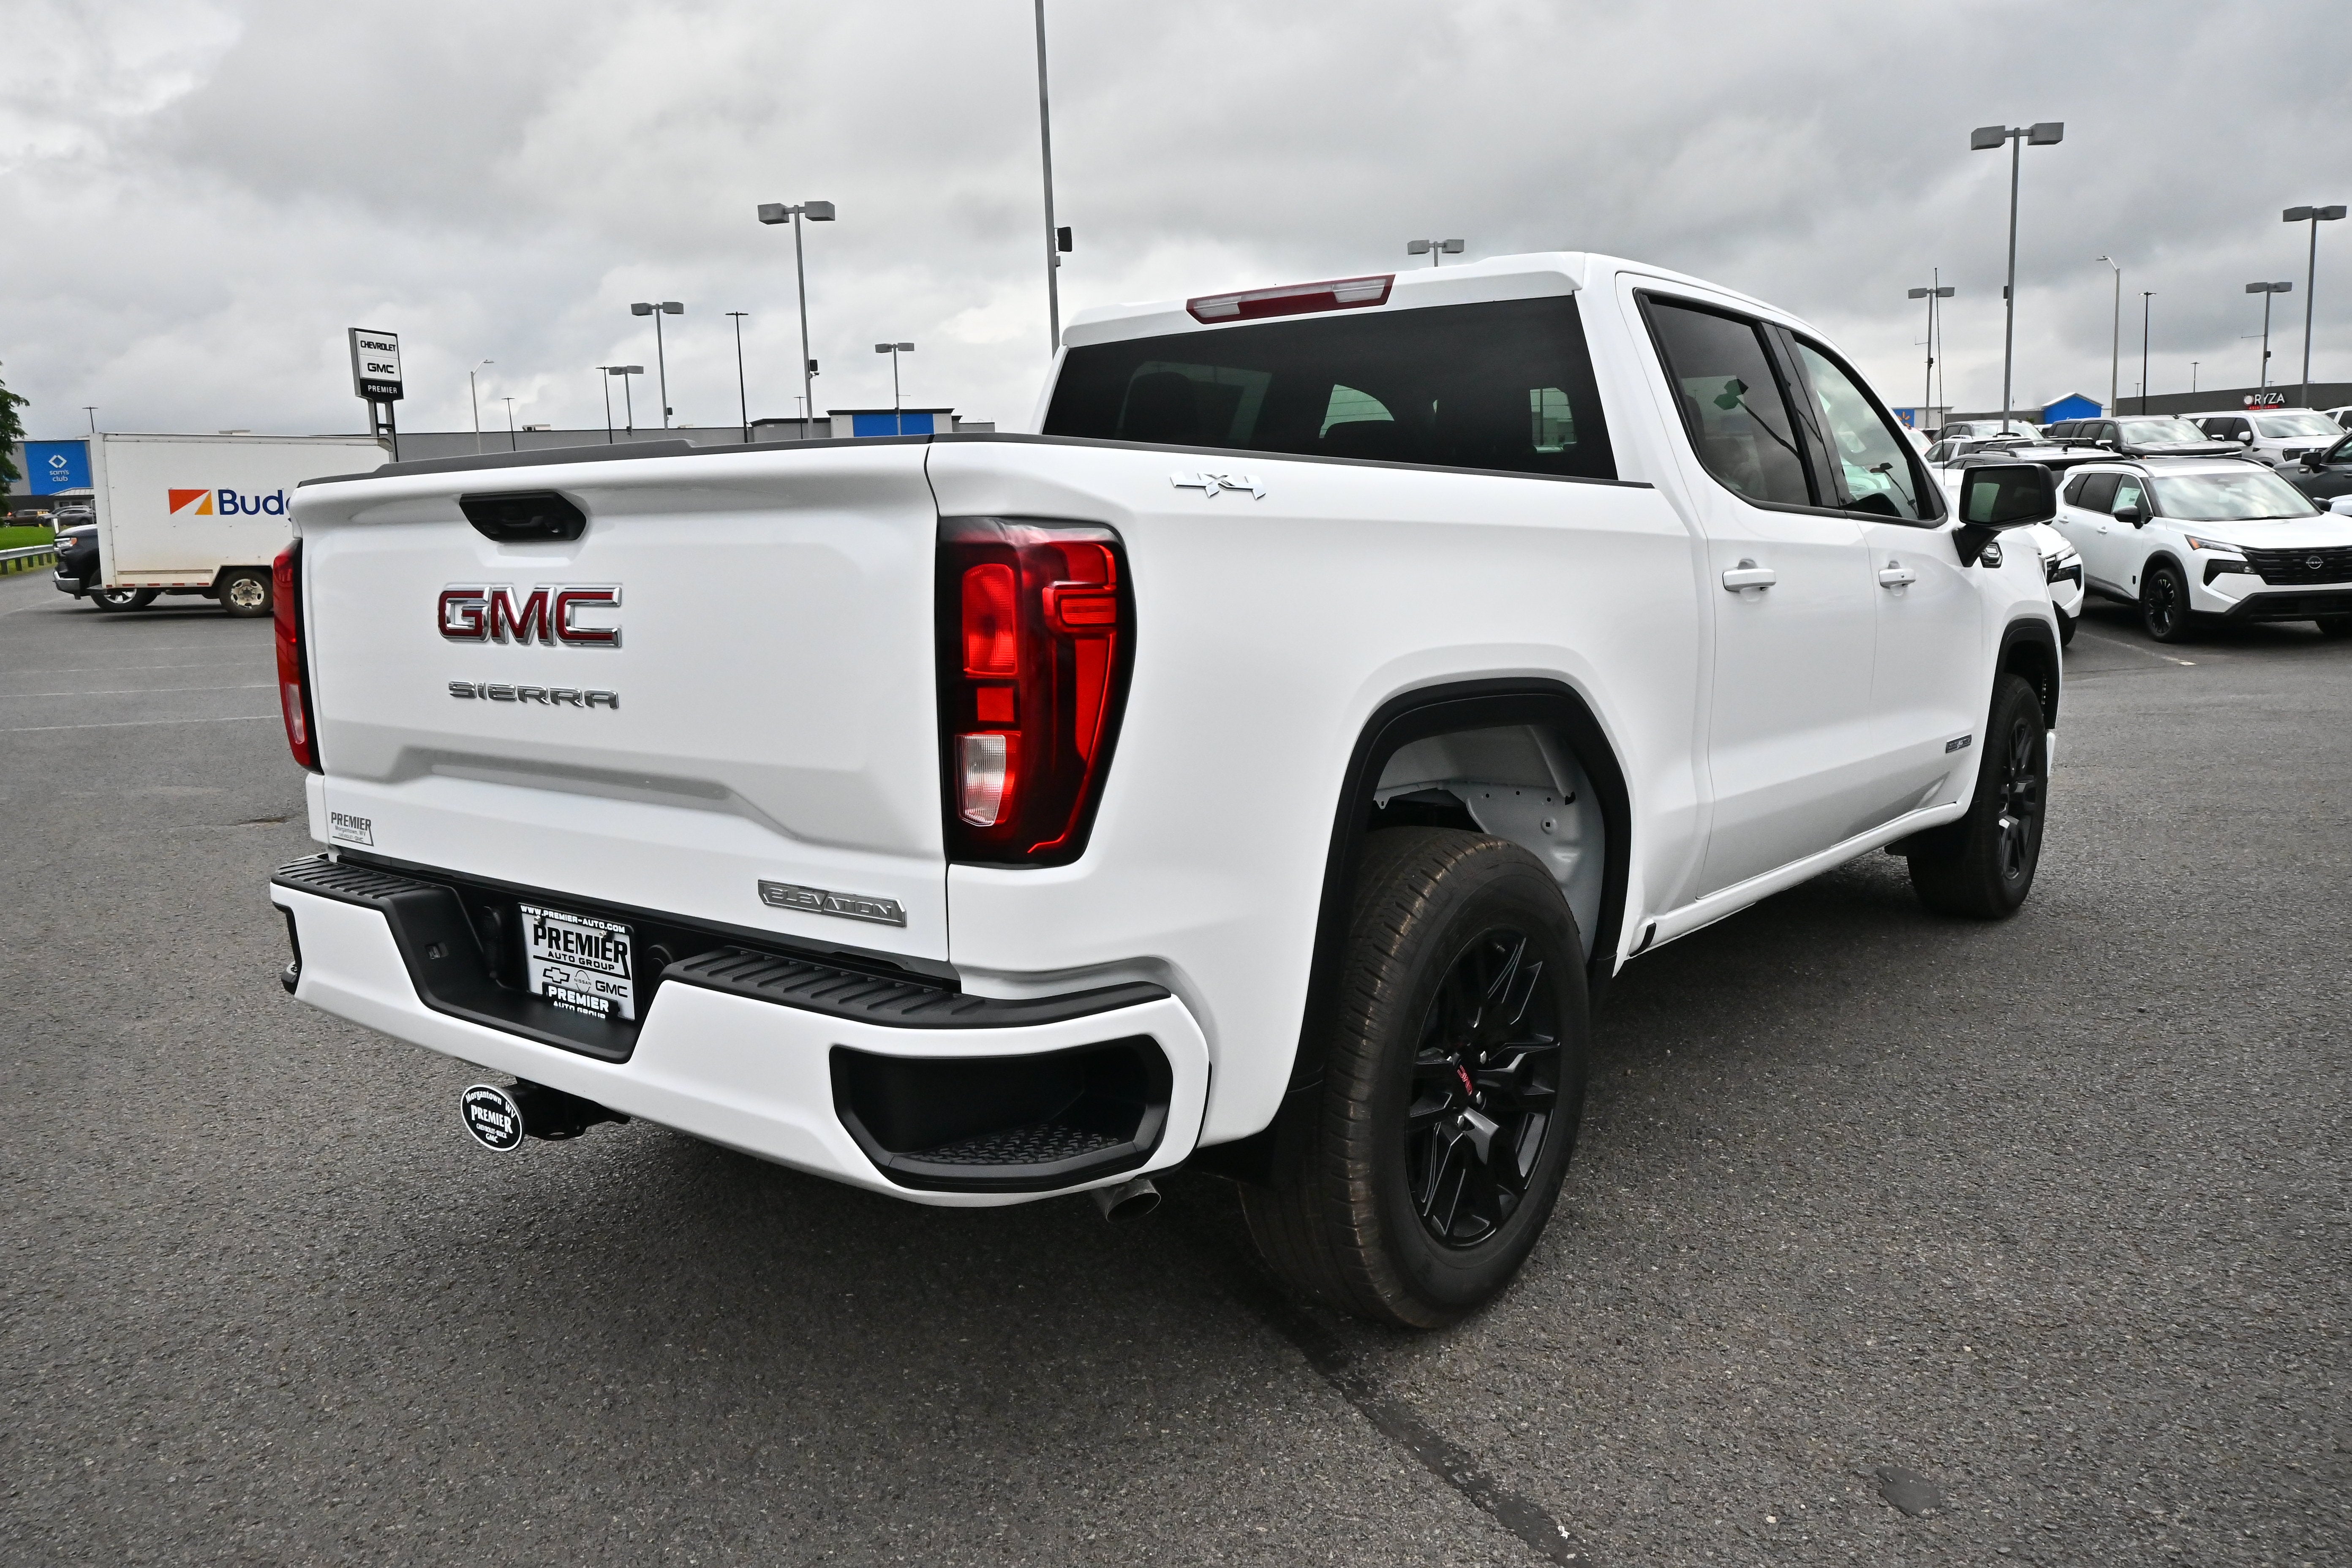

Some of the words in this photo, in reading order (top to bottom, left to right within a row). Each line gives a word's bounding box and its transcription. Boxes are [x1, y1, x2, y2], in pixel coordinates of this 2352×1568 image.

[360, 340, 396, 351] CHEVROLET
[367, 362, 395, 374] GMC
[368, 384, 397, 394] PREMIER
[218, 490, 291, 522] Bud
[437, 586, 623, 648] GMC
[448, 680, 619, 710] SIERRA
[331, 811, 371, 831] PREMIER
[768, 887, 892, 917] ELEVATION
[520, 905, 625, 934] WWW.PREMIER-AUTO.COM
[533, 924, 628, 964] PREMIER
[548, 951, 575, 963] AUTO
[578, 957, 615, 971] GROUP
[548, 985, 609, 1013] PREMIER
[595, 980, 628, 998] GMC
[465, 1091, 502, 1105] Morgantown
[505, 1101, 516, 1119] WV
[471, 1104, 513, 1134] PREMIER
[485, 1133, 498, 1143] GMC
